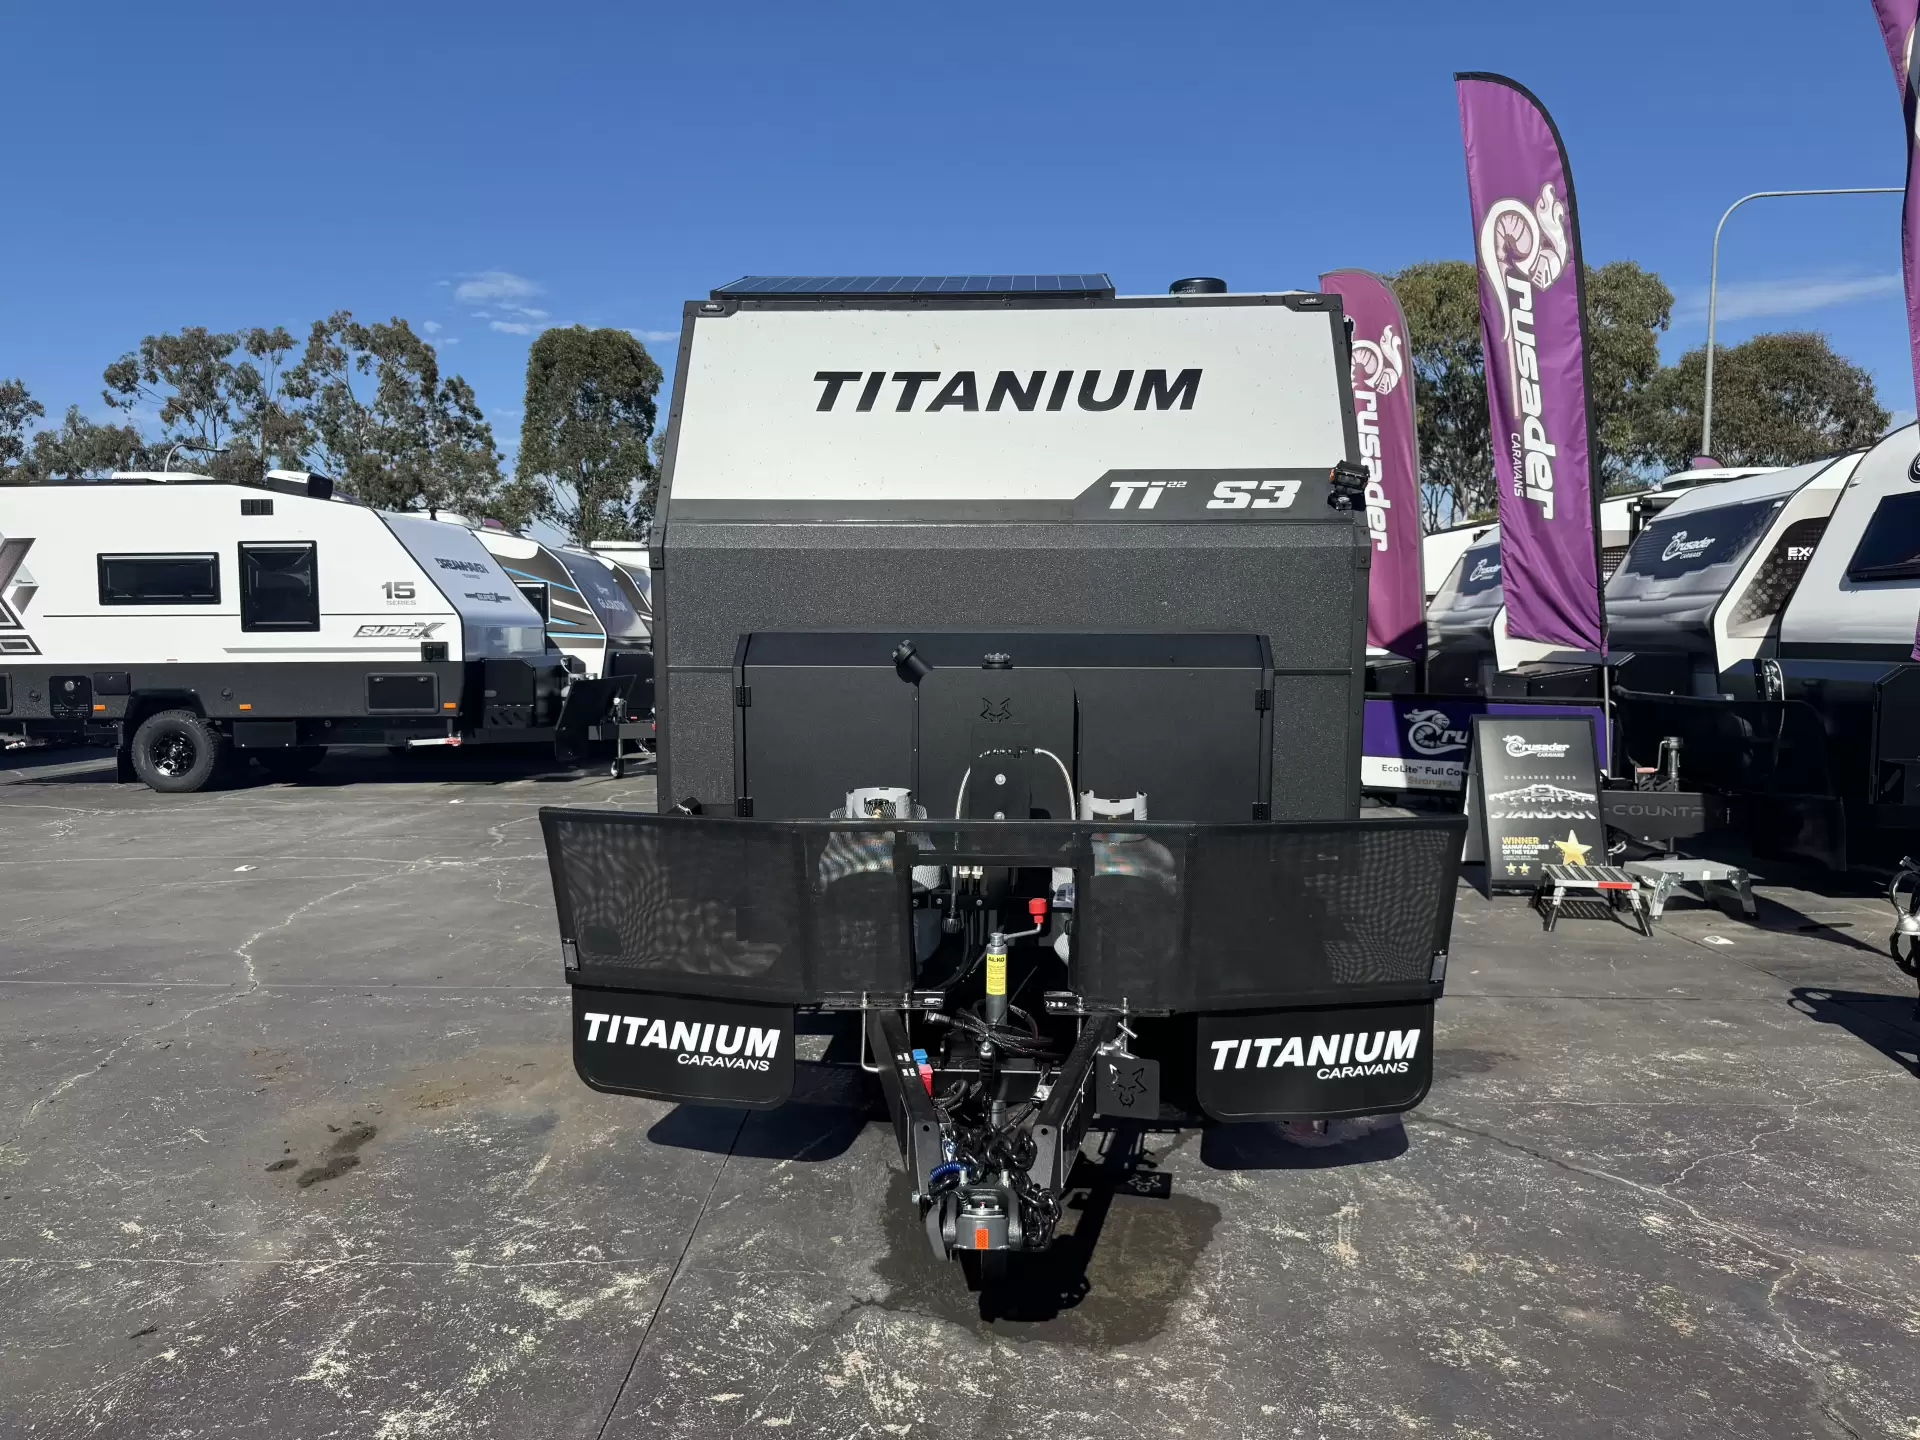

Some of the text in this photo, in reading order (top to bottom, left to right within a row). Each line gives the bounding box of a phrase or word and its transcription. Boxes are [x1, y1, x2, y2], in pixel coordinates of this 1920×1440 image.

[1480, 198, 1556, 519] Crusader
[813, 368, 1203, 413] TITANIUM
[1510, 432, 1524, 498] CARAVANS
[1206, 480, 1302, 509] S3
[1787, 546, 1814, 557] EX
[382, 581, 416, 600] 15
[1408, 721, 1469, 755] Cru
[1506, 741, 1570, 757] Crusader
[1425, 767, 1444, 775] Full
[1603, 804, 1705, 818] -COUNTR
[1502, 836, 1540, 845] WINNER
[584, 1012, 781, 1059] TITANIUM
[1210, 1029, 1421, 1071] TITANIUM
[677, 1053, 770, 1072] CARAVANS
[1316, 1061, 1409, 1080] CARAVANS
